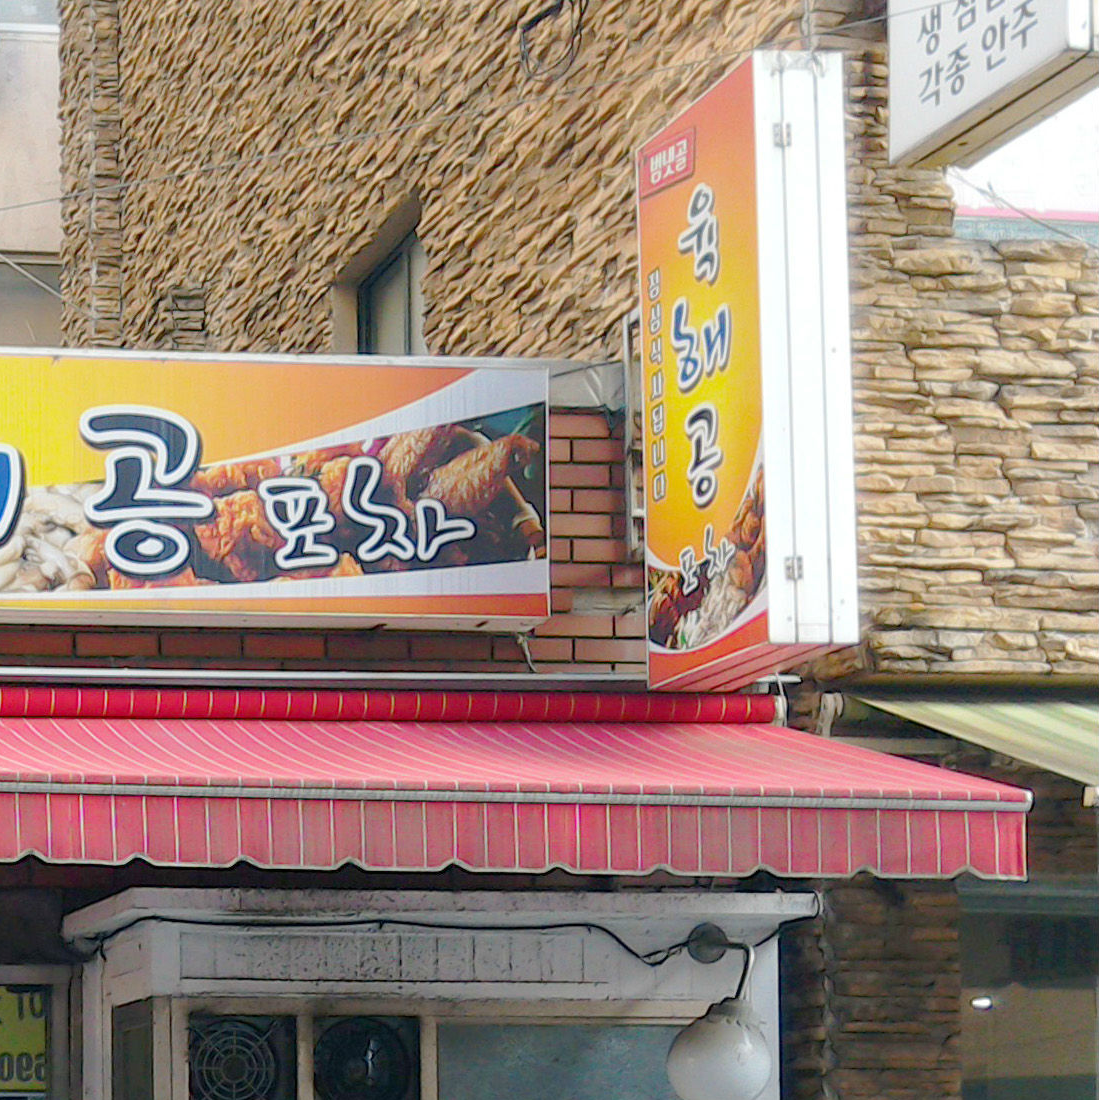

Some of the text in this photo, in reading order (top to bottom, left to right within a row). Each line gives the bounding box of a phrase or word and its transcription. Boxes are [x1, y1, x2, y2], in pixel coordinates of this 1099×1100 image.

[919, 0, 1038, 106] 각종 안주
[649, 137, 688, 186] 범냇골
[258, 455, 476, 569] 포차
